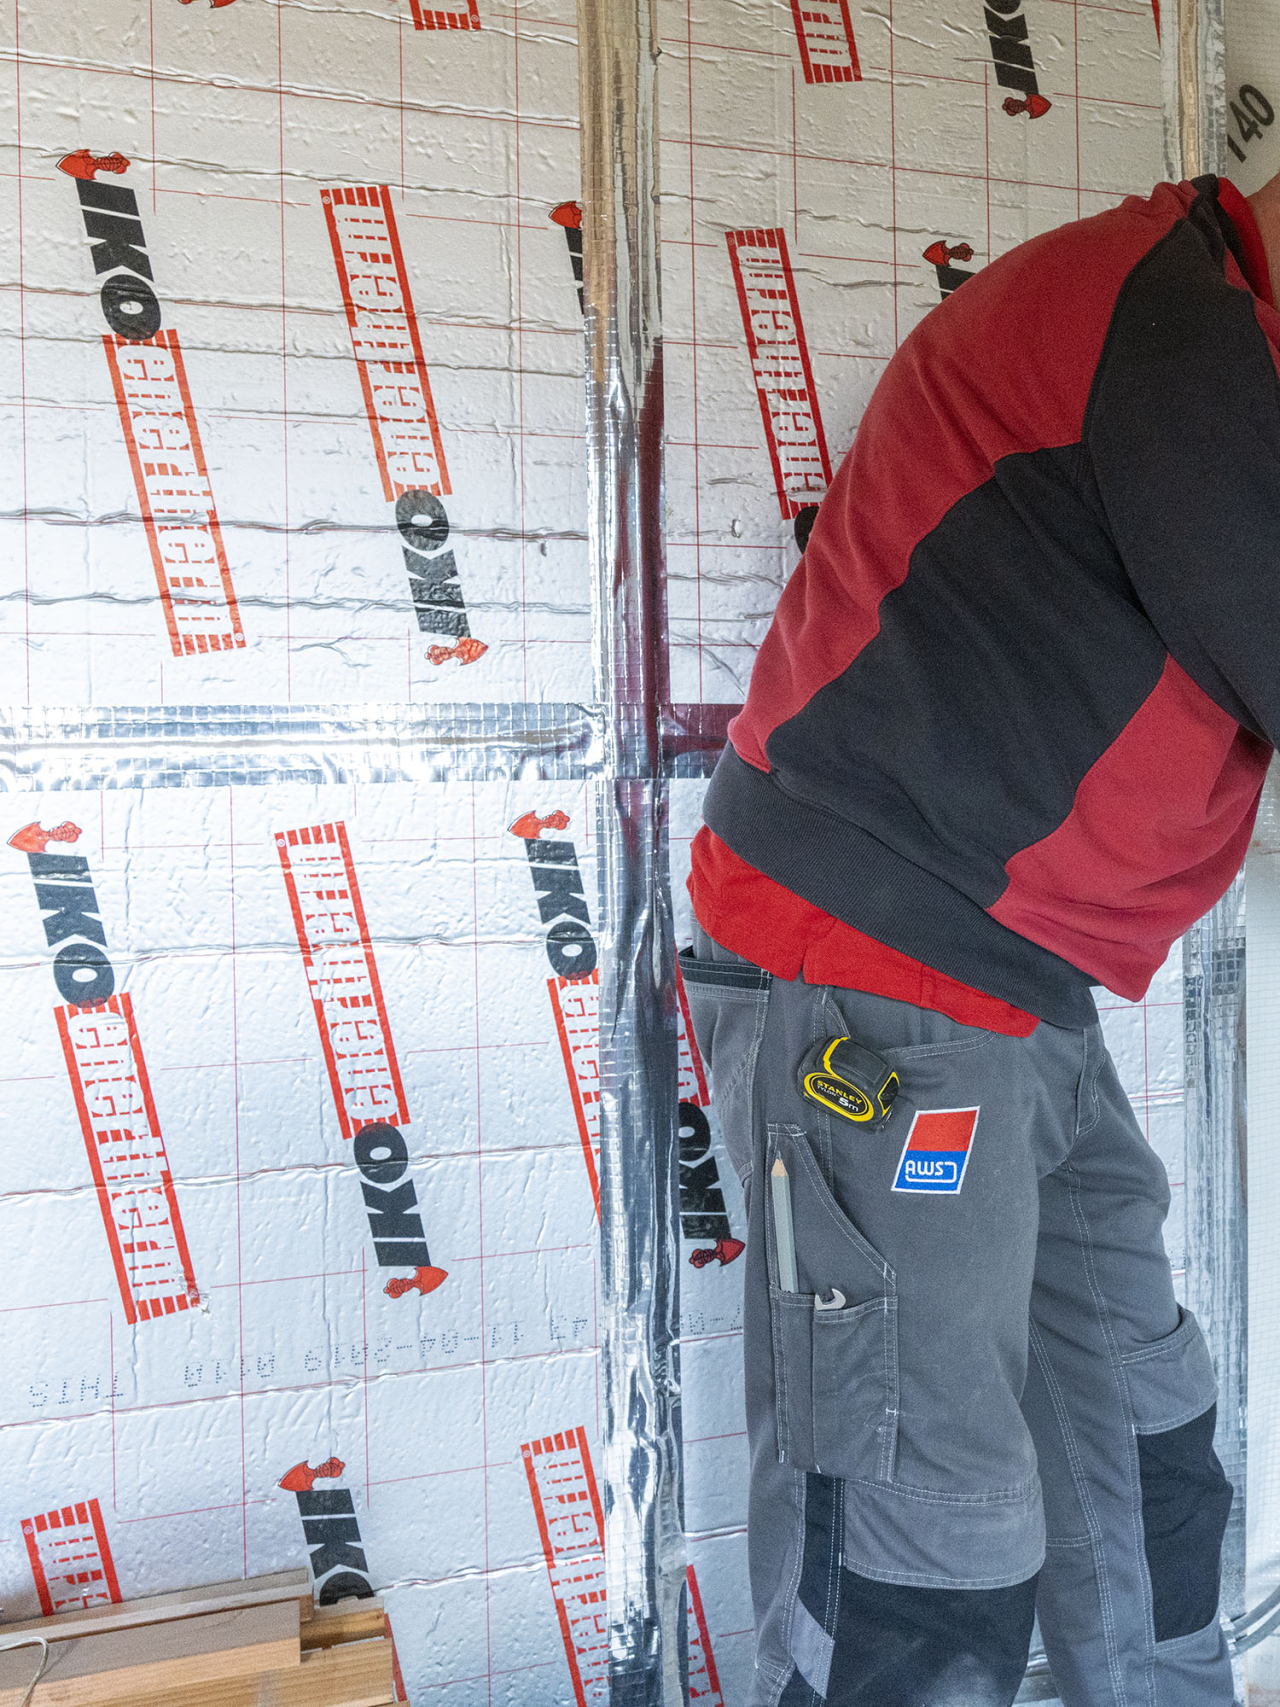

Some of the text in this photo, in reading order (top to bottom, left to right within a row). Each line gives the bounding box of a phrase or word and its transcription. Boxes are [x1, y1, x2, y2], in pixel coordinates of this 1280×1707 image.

[983, 0, 1040, 95] IK
[1227, 84, 1274, 163] 140
[75, 178, 236, 638] IKO enertherm
[333, 202, 471, 637] IKO enertherm
[737, 244, 827, 503] enertherm
[524, 839, 599, 980] IKO
[28, 852, 180, 1303] IKO enertherm
[291, 848, 431, 1267] IKO enertherm
[817, 1080, 862, 1104] STANLEY
[838, 1097, 859, 1112] 5m
[905, 1160, 944, 1176] AWS
[29, 1371, 125, 1408] THIS
